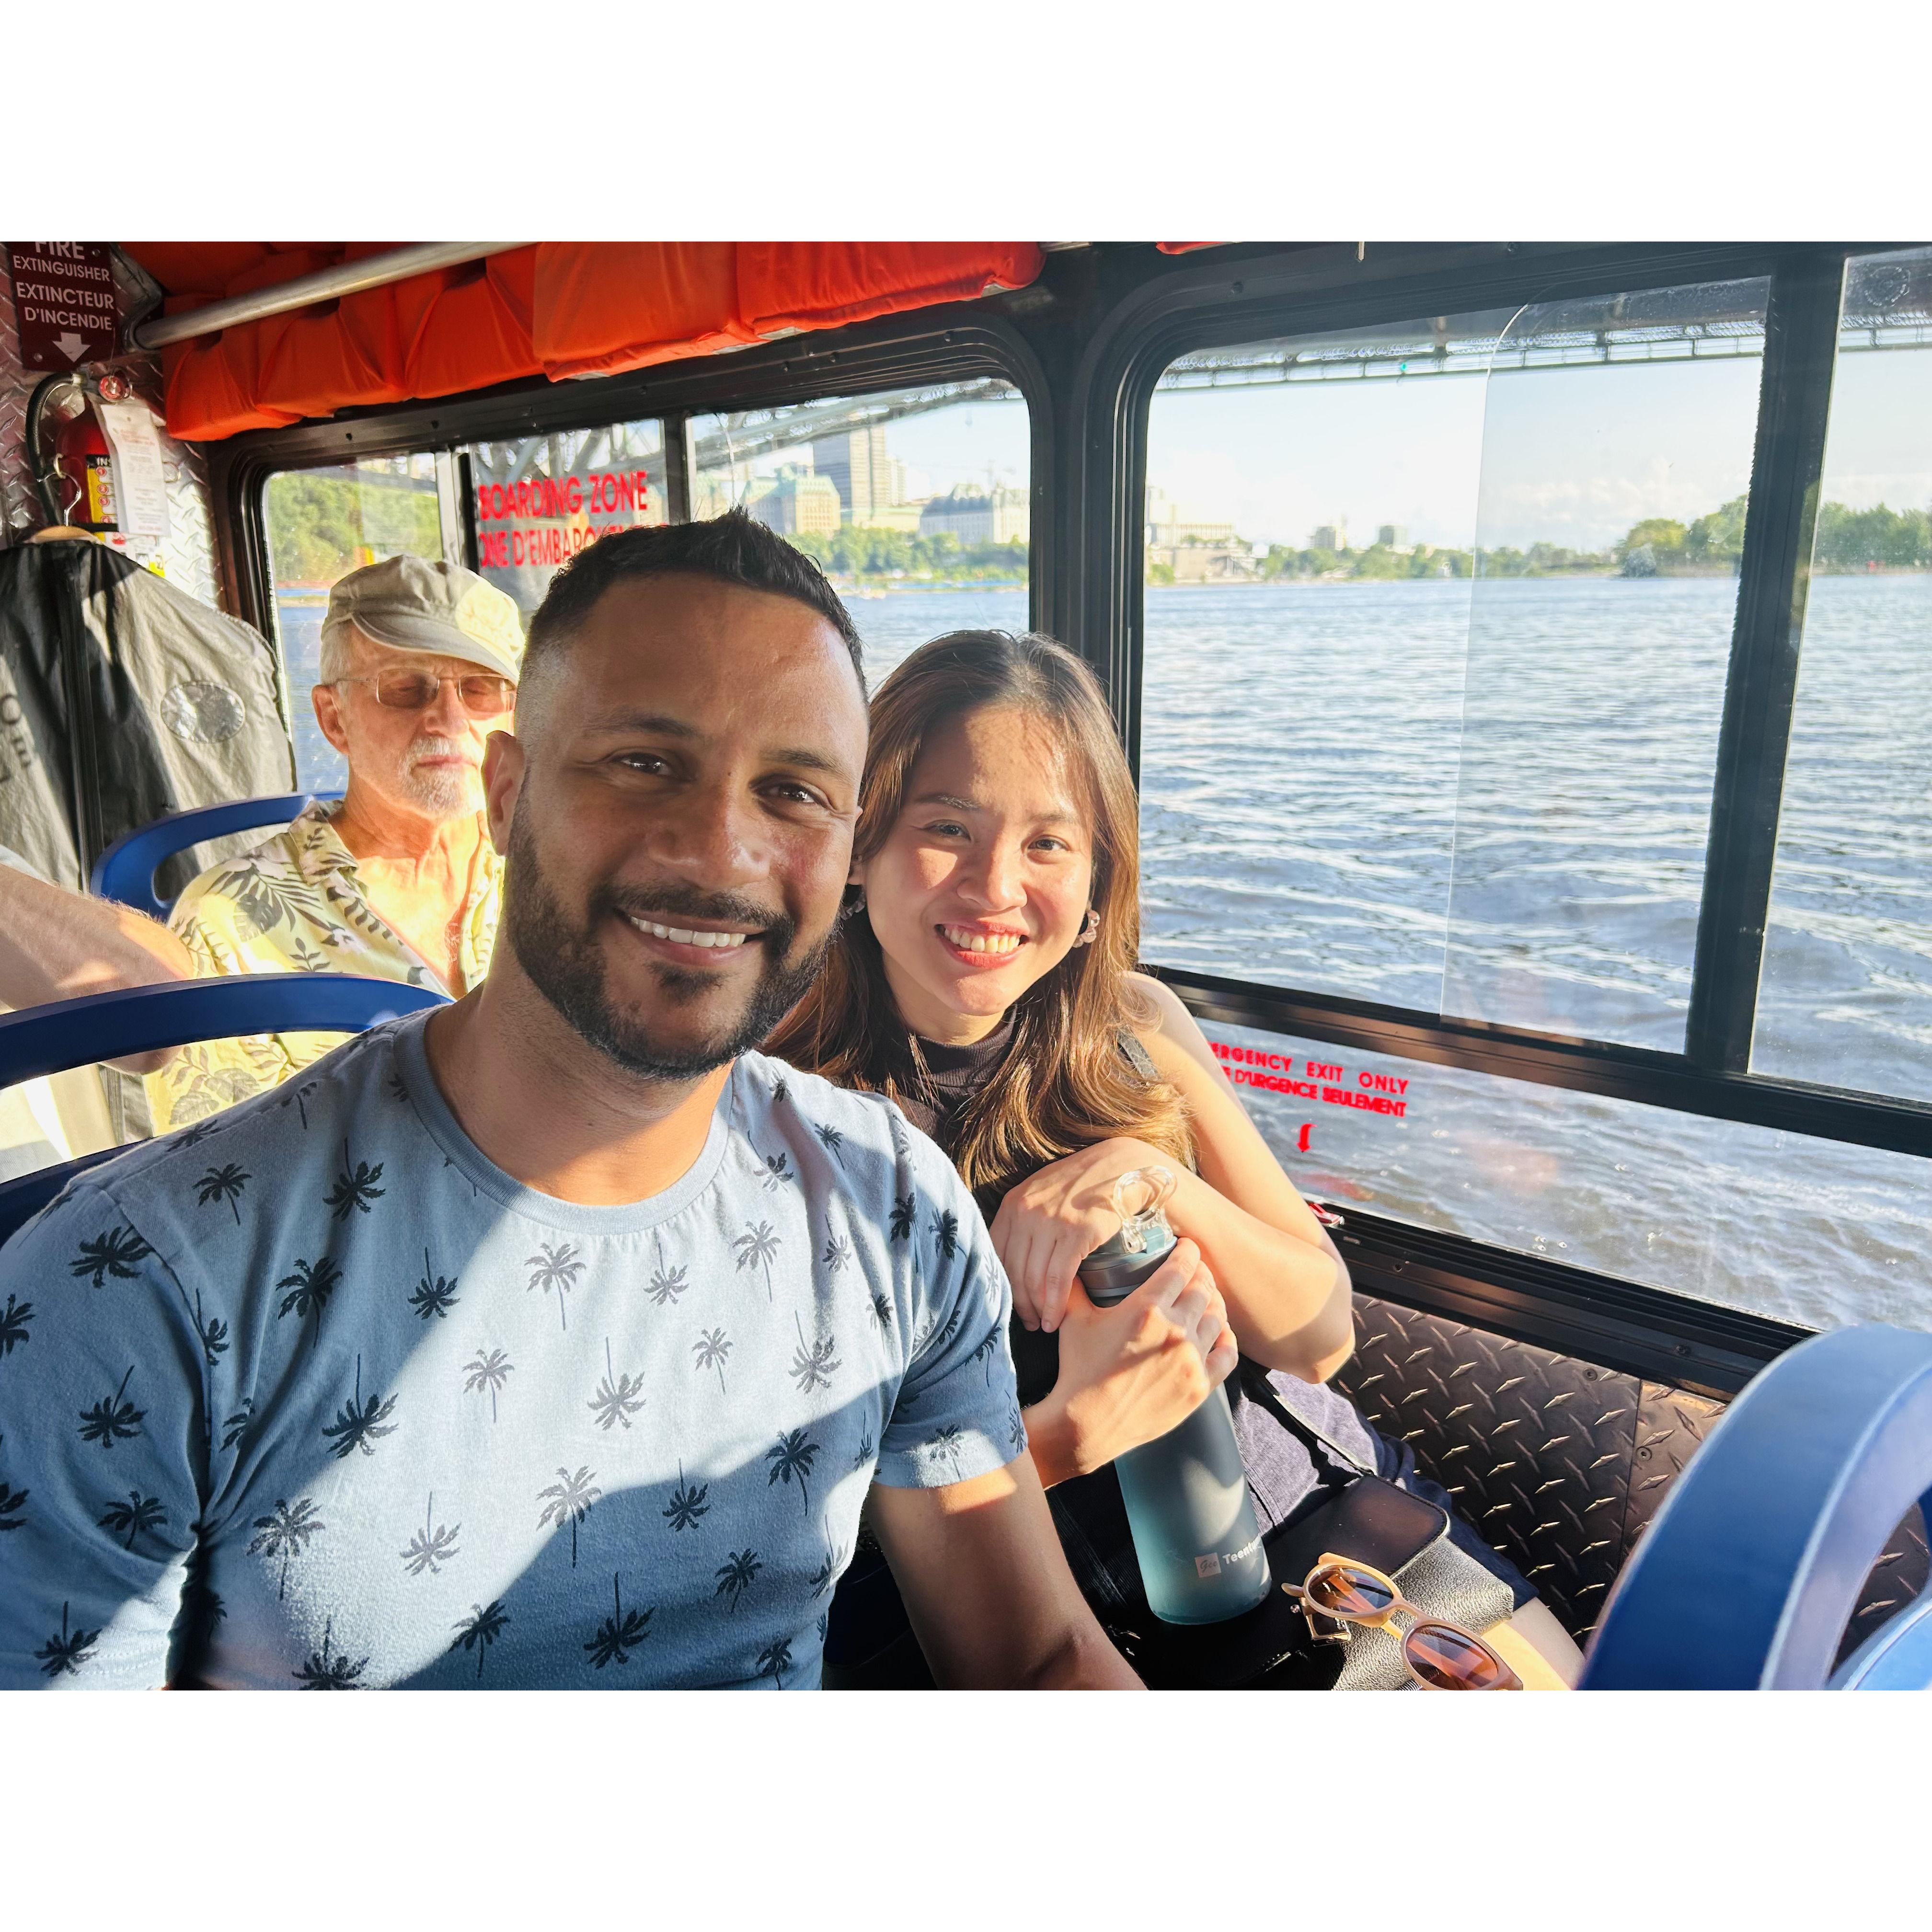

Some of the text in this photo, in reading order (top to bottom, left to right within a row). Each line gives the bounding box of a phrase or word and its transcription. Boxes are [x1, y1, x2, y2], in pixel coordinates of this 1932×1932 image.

[34, 242, 85, 260] FIRE
[13, 255, 110, 282] EXTINGUISHER
[16, 282, 115, 310] EXTINCTEUR
[24, 307, 112, 331] D'INCENDIE
[478, 470, 648, 521] BOARDING ZONE
[1207, 1041, 1410, 1095] ERGENCY EXIT ONLY
[1234, 1069, 1319, 1101] D'URGENCE
[1322, 1086, 1408, 1118] SEULEMENT
